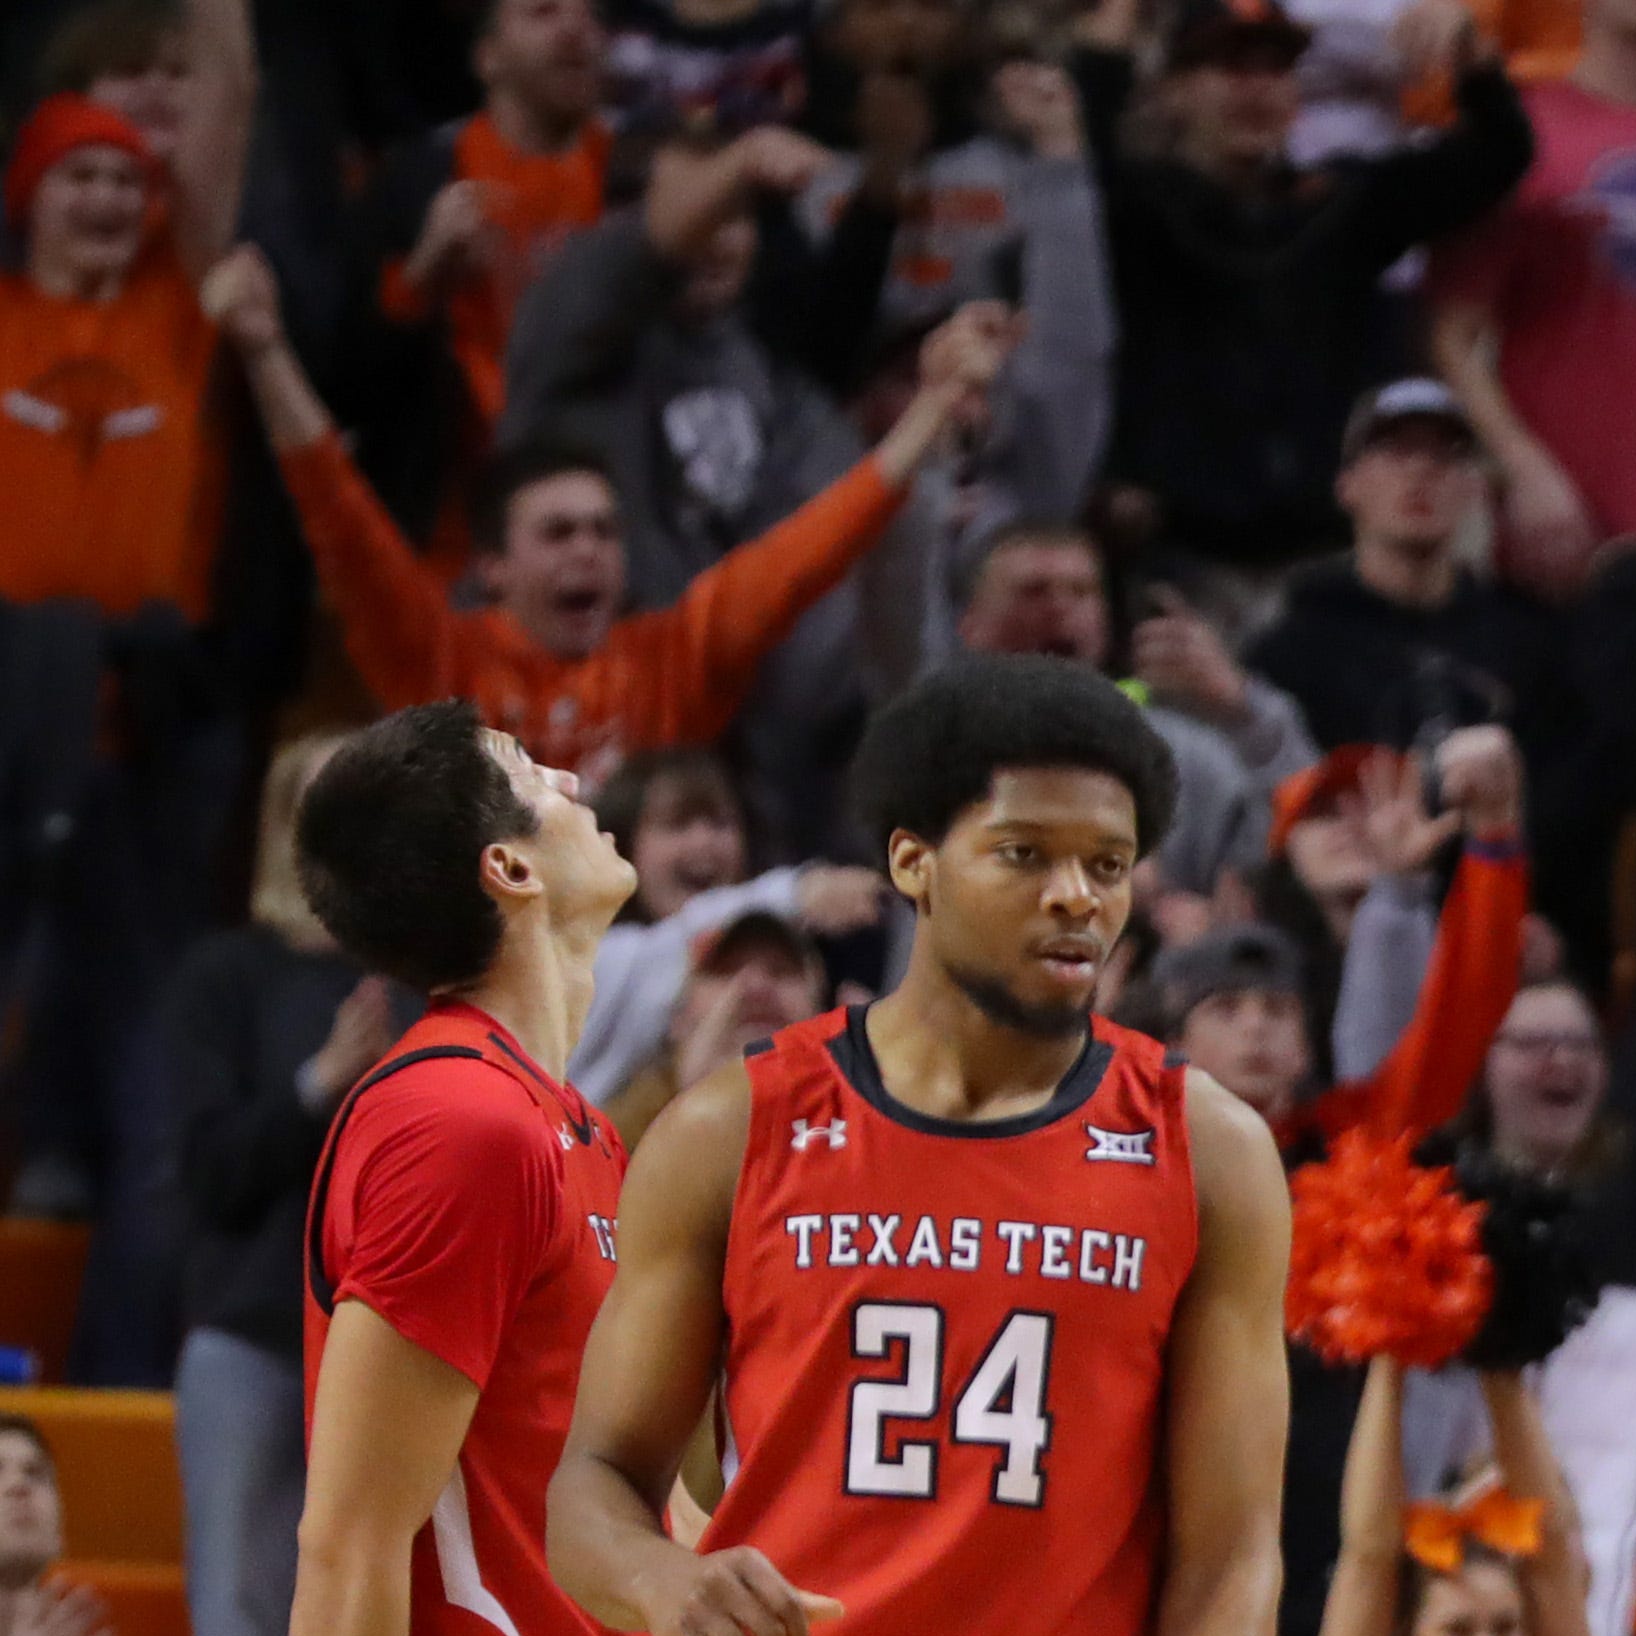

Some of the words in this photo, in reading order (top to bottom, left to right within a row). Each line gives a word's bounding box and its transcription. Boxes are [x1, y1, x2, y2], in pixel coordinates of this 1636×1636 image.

[786, 1213, 981, 1271] TEXAS
[997, 1218, 1148, 1291] TECH
[842, 1300, 1056, 1508] 24
